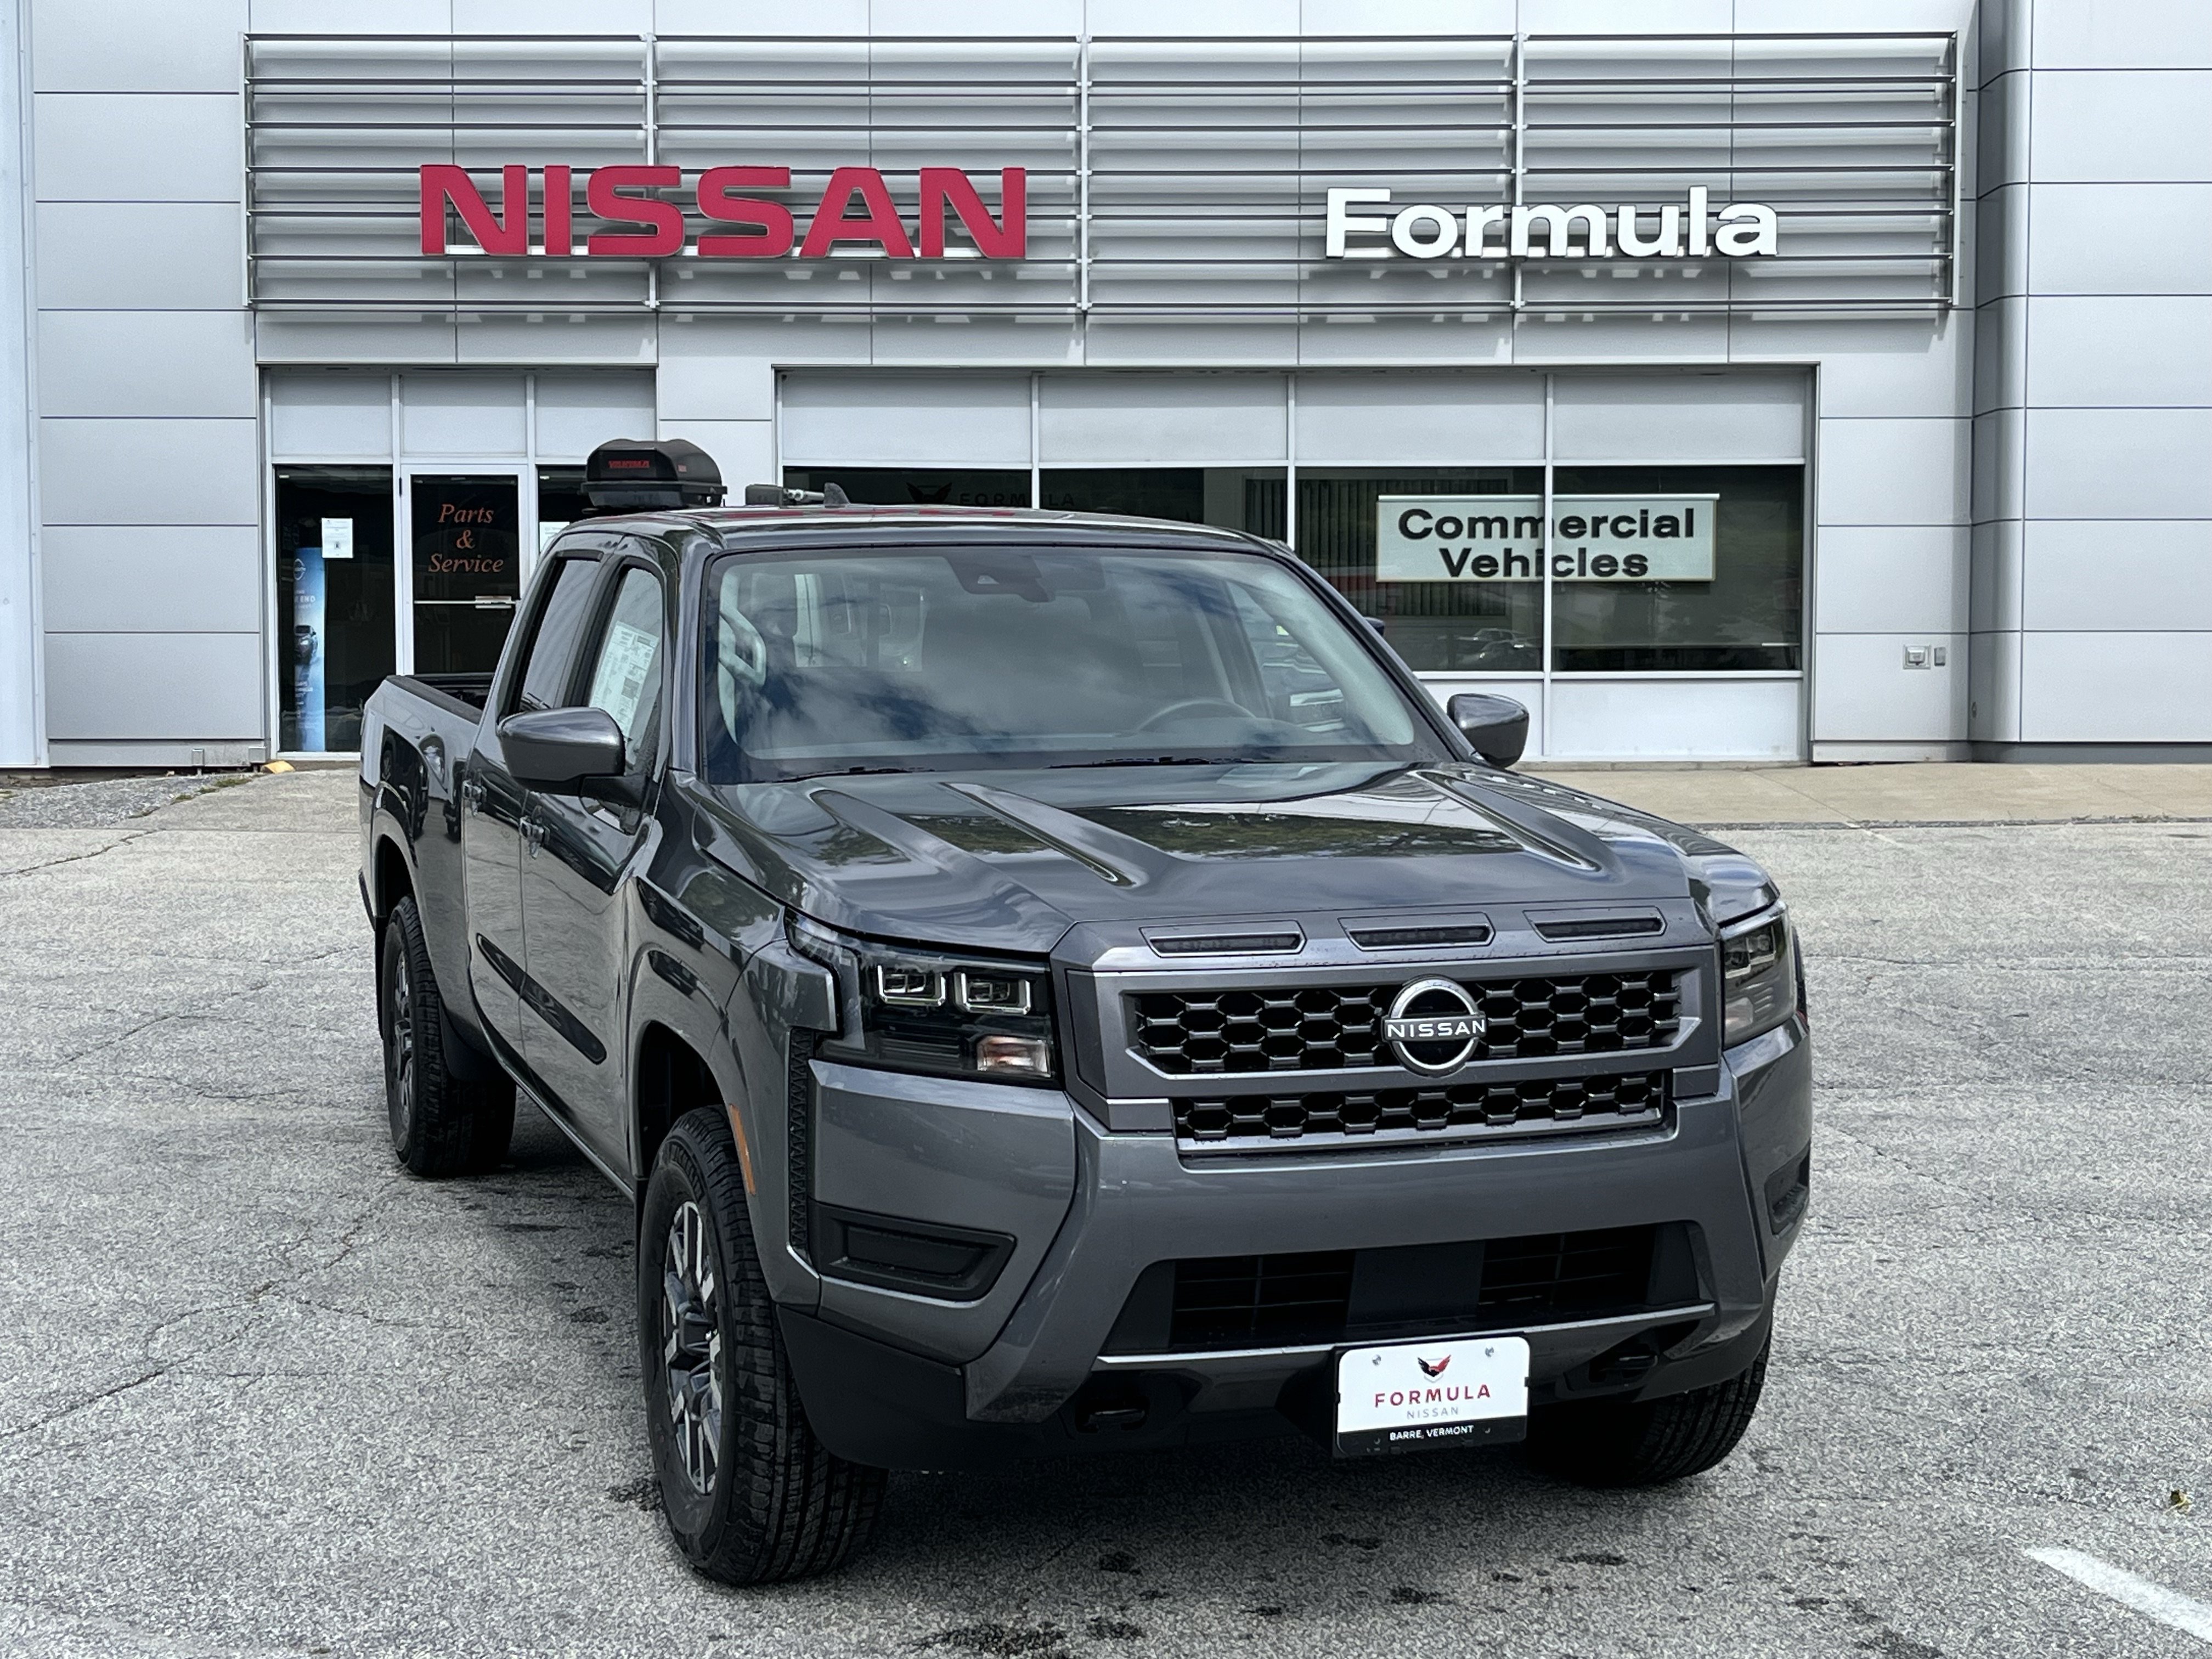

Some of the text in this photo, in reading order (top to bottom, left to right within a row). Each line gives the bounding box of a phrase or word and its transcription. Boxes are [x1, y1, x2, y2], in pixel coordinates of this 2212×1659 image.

[420, 165, 1026, 259] NISSAN
[1325, 185, 1778, 259] Formula
[438, 504, 494, 524] Parts
[1398, 508, 1694, 539] Commercial
[455, 529, 476, 550] &
[428, 553, 505, 574] Service
[1440, 548, 1649, 578] Vehicles
[1387, 1020, 1485, 1037] NISSAN
[1375, 1385, 1490, 1408] FORMULA
[1407, 1407, 1459, 1419] NISSAN
[1390, 1425, 1474, 1441] BARRE, VERMONT
